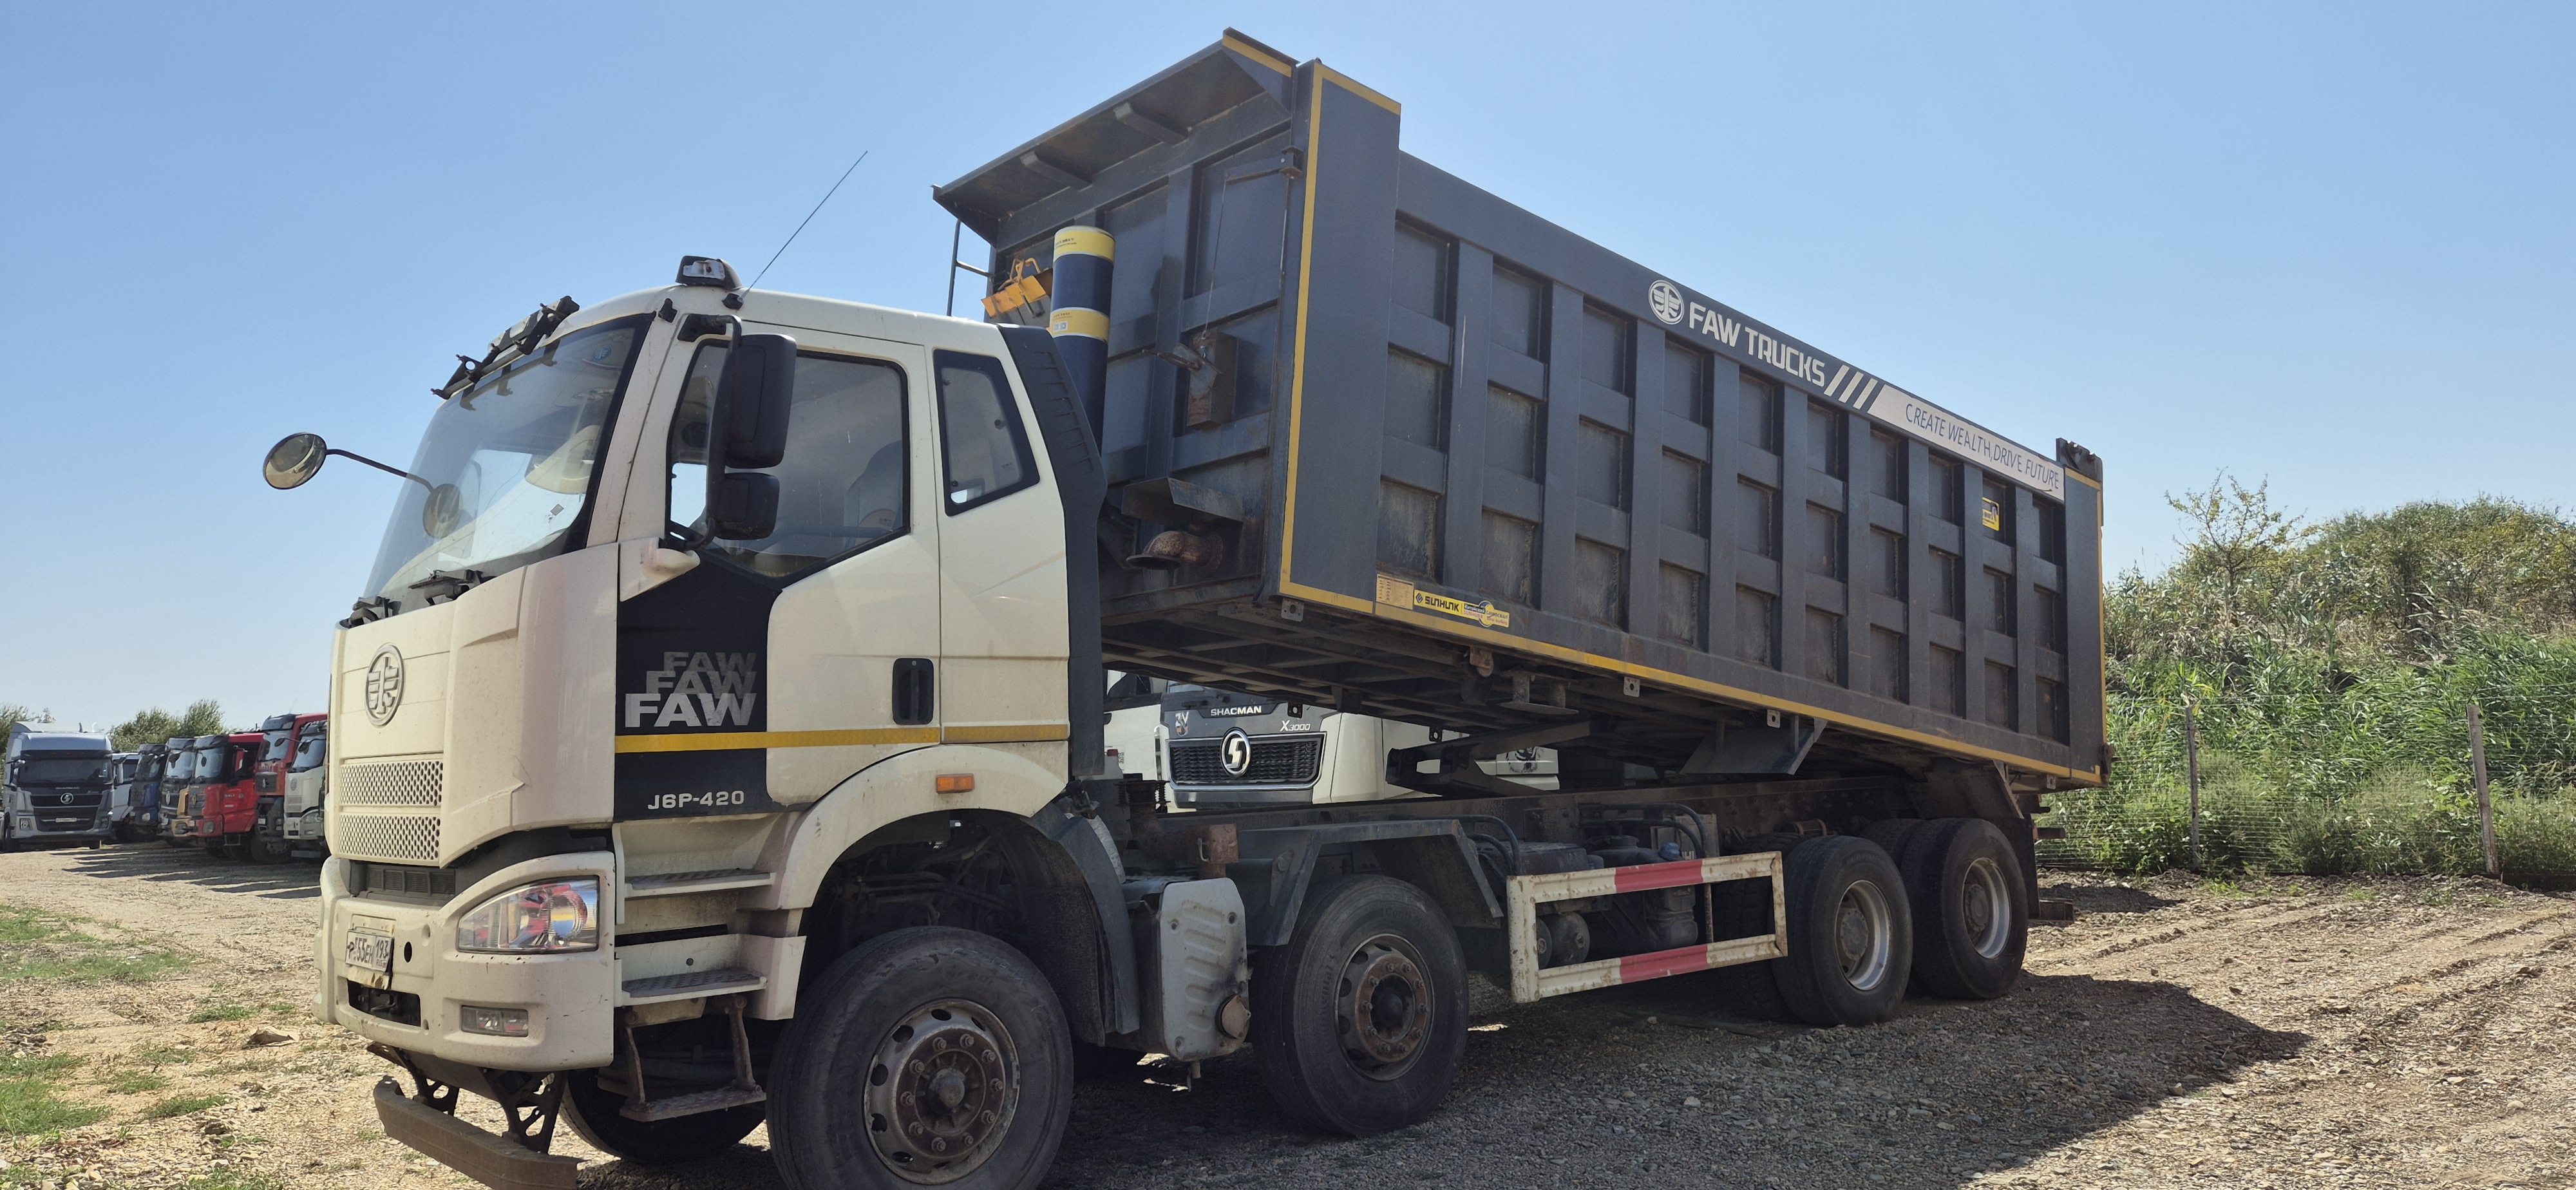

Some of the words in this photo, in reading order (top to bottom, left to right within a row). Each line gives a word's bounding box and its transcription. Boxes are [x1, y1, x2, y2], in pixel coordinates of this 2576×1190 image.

[1689, 301, 1741, 347] FAW
[1745, 326, 1825, 387] TRUCKS
[1906, 404, 1946, 437] CREATE
[2025, 460, 2060, 489] FUTURE
[664, 652, 757, 674] FAW
[647, 670, 757, 699] FAW
[625, 693, 757, 727] FAW
[1211, 706, 1262, 716] SHACMAN
[1280, 720, 1311, 732] X3000
[648, 791, 744, 809] J6P-420
[376, 940, 389, 958] 193
